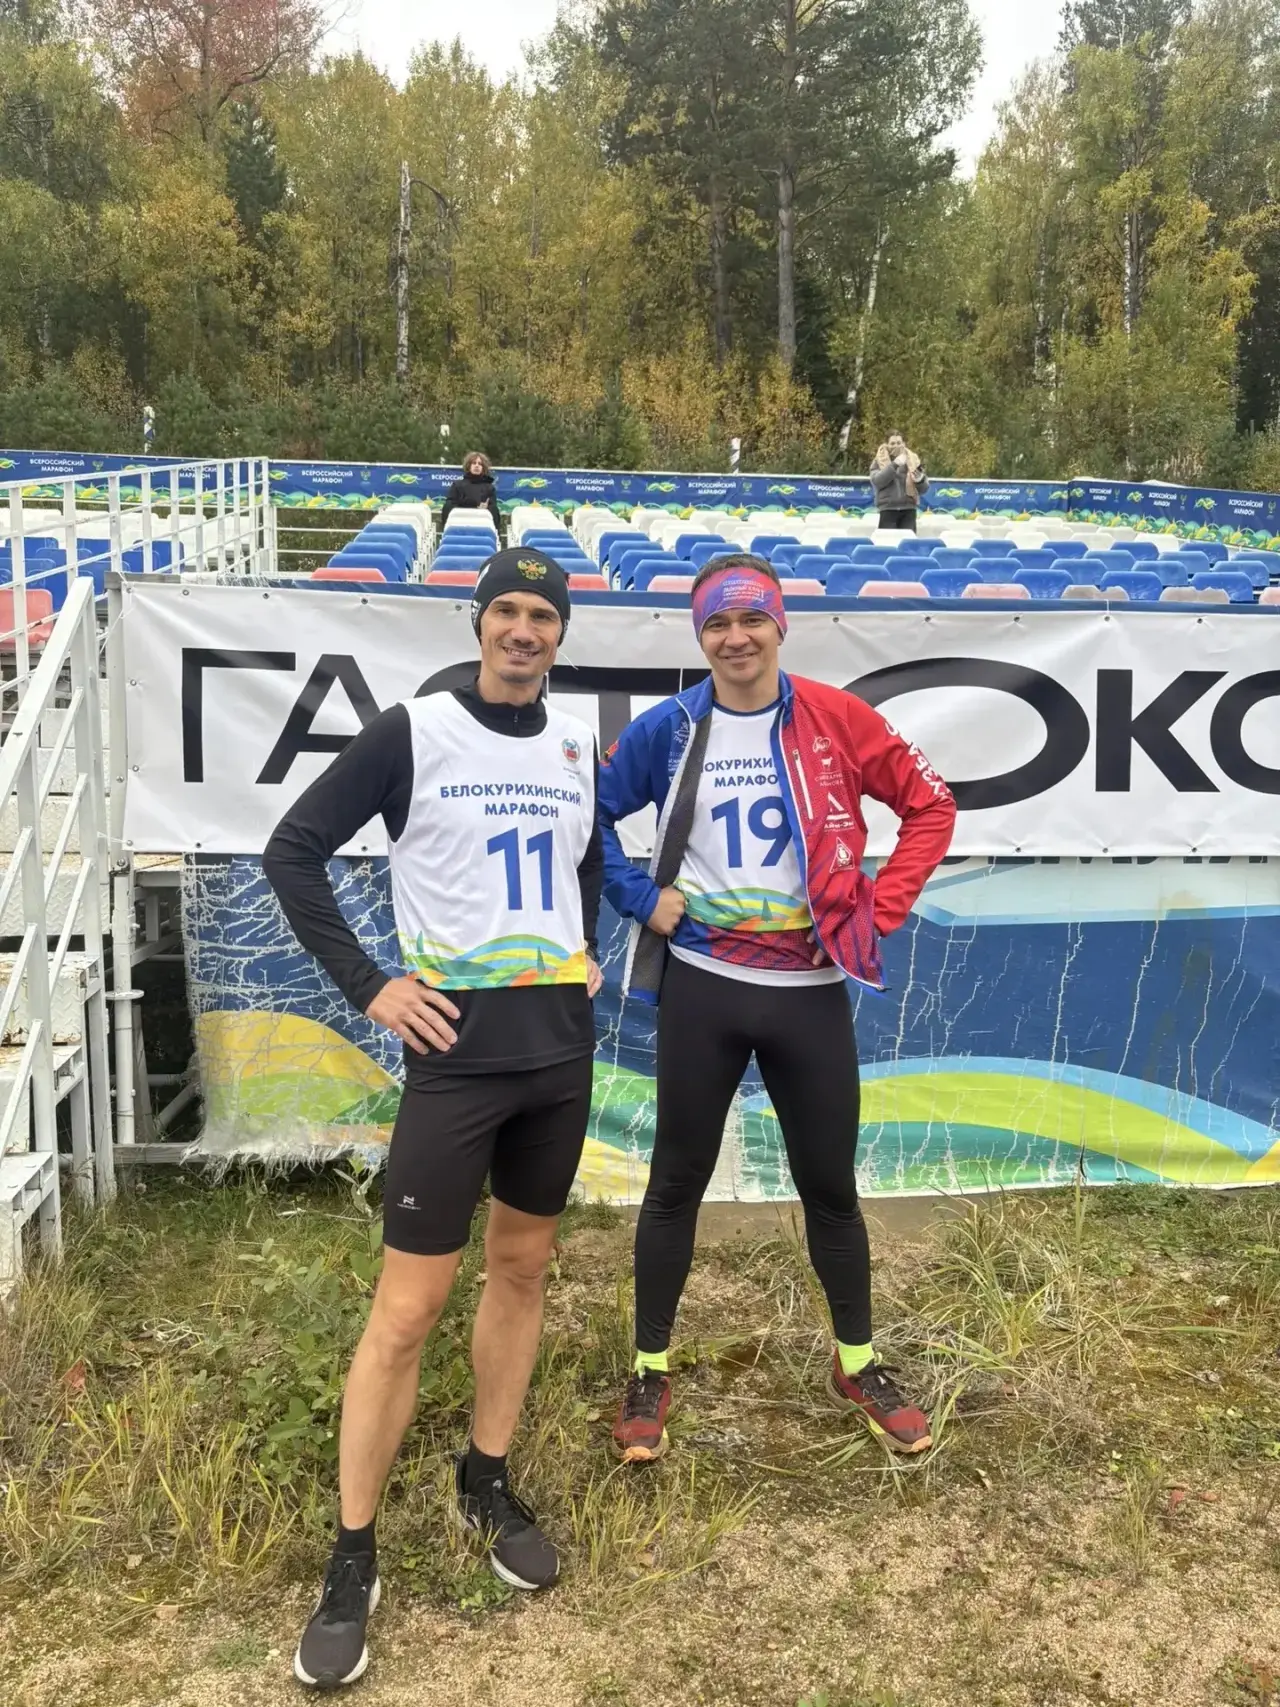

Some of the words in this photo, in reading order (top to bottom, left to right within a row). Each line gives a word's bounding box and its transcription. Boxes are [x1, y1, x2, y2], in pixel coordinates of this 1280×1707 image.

[29, 458, 85, 466] ВСЕРОССИЙСКИЙ
[41, 465, 74, 473] МАРАФОН
[180, 472, 211, 480] МАРАОН
[301, 469, 353, 477] ВСЕРОССИЙСКИЙ
[565, 477, 615, 486] ВСЕРОССИЙСКИЙ
[703, 757, 774, 772] ОКУРИХИ
[714, 774, 779, 788] МАРАФО
[440, 783, 581, 806] БЕЛОКУРИХИНСКИЙ
[485, 803, 559, 818] МАРАФОН
[711, 796, 793, 868] 19
[487, 827, 554, 911] 11
